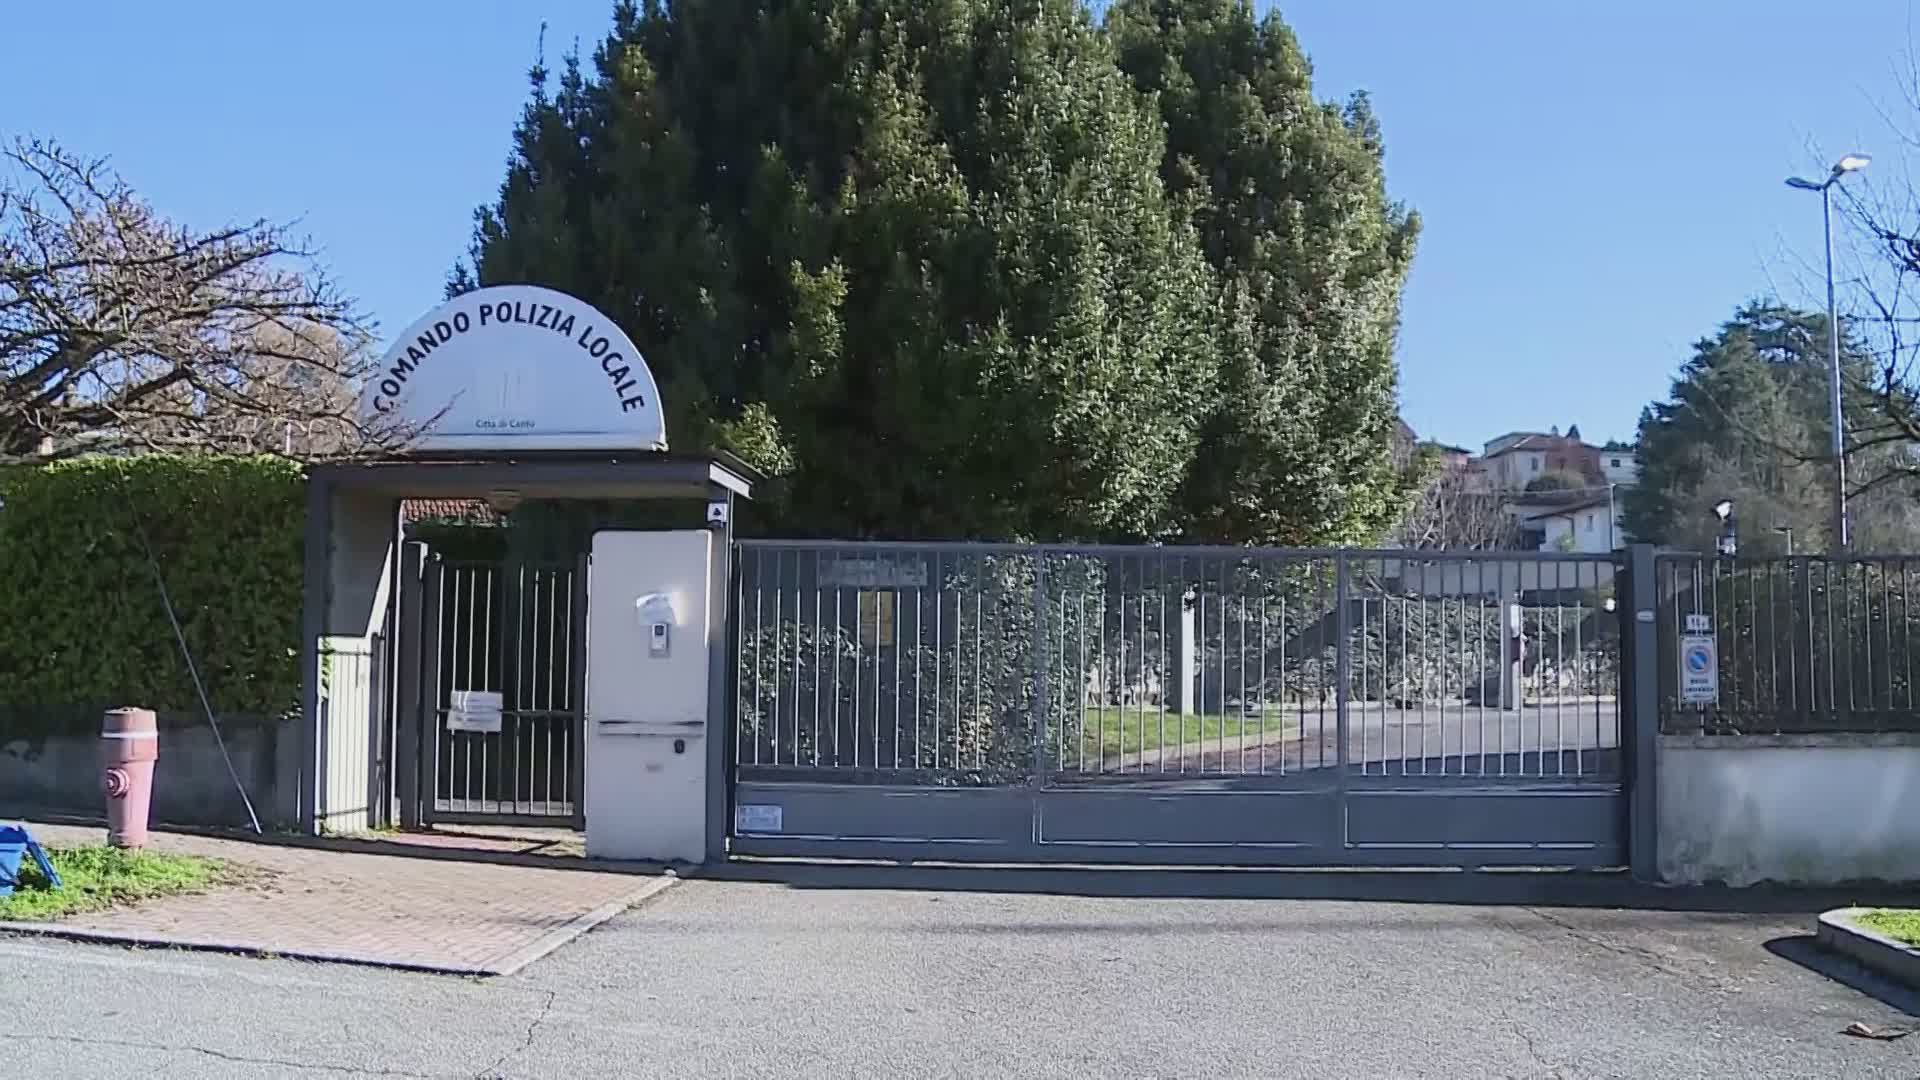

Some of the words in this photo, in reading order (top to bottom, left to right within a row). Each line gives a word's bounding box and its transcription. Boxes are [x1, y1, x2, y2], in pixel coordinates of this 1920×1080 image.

[373, 311, 470, 412] COMANDO
[479, 301, 576, 337] POLIZIA
[577, 325, 645, 413] LOCALE
